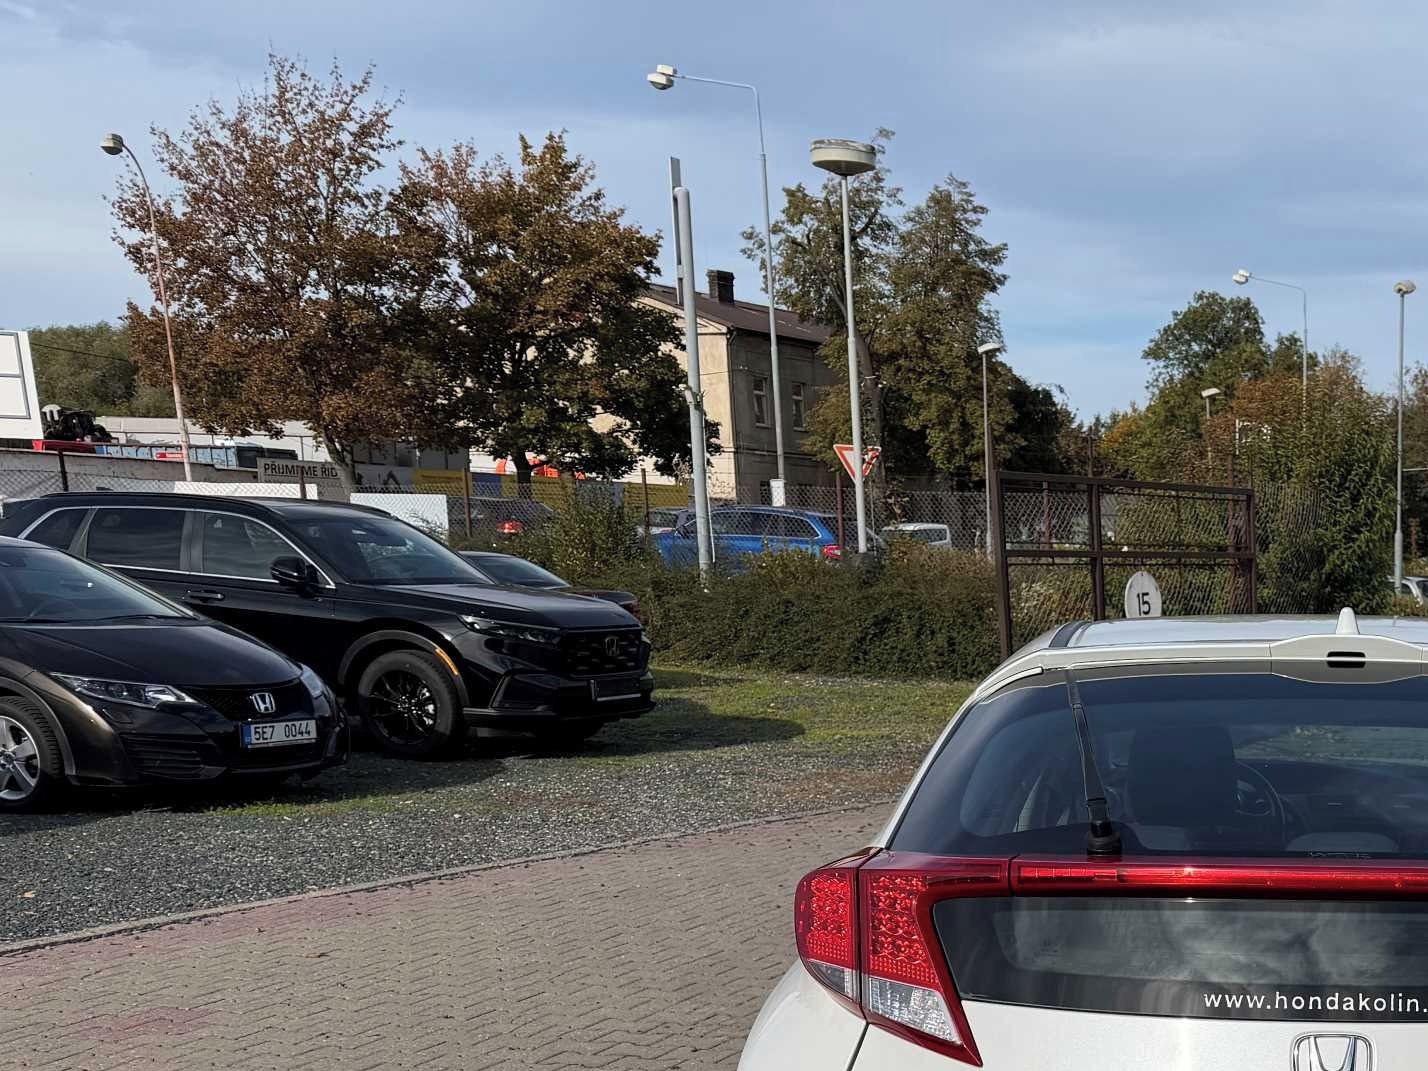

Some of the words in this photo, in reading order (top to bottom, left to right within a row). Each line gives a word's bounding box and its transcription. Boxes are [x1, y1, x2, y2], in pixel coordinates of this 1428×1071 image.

[263, 460, 318, 478] PŘIJMME
[1136, 592, 1151, 616] 15
[253, 725, 276, 741] 5E7
[284, 722, 311, 738] 0044
